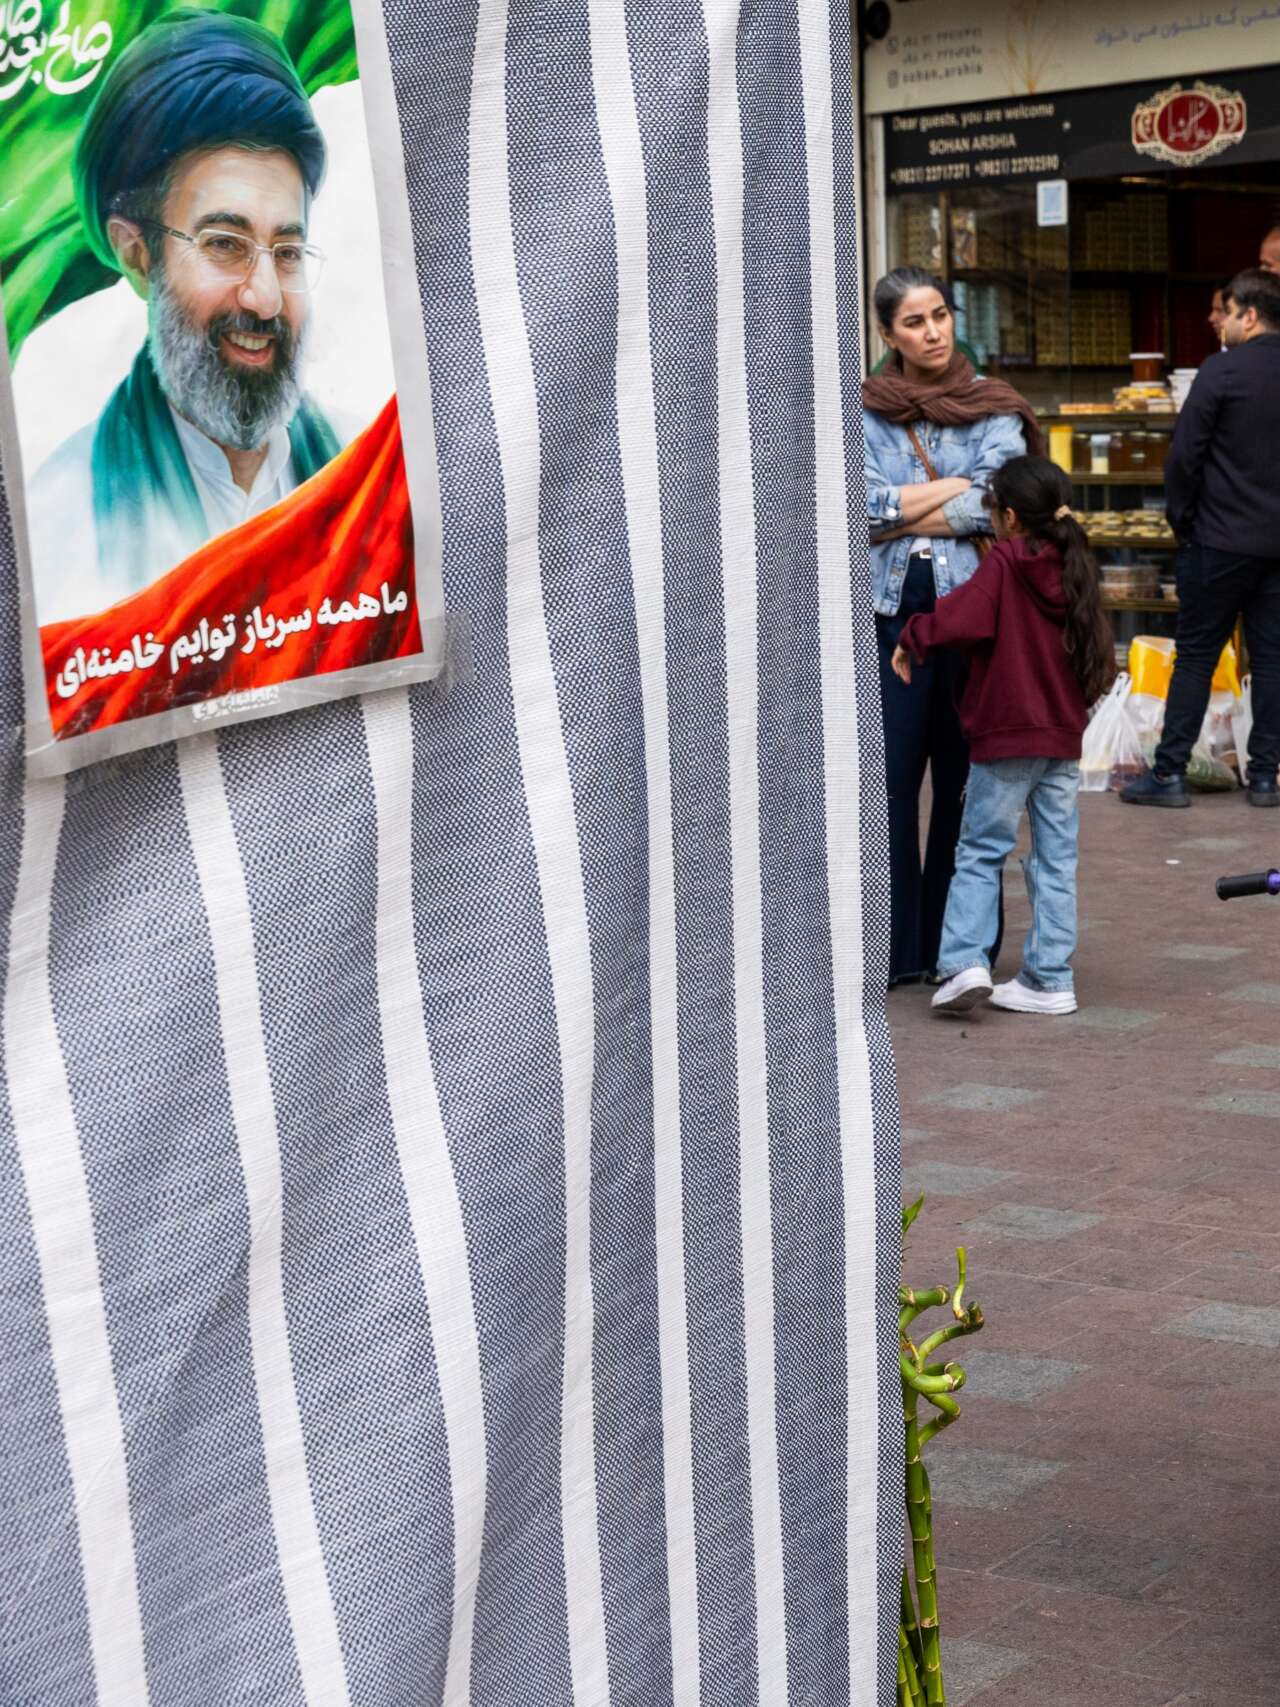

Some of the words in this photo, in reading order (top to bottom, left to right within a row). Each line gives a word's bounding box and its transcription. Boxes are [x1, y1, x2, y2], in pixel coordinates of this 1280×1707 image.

[44, 0, 113, 95] صالح
[892, 116, 918, 131] Dear
[961, 111, 983, 128] you
[984, 109, 1003, 122] are
[1004, 104, 1055, 120] welcome
[928, 137, 971, 156] SOHAN
[971, 133, 1017, 151] ARSHIA
[316, 591, 379, 626] همه
[380, 582, 409, 614] ما
[170, 613, 237, 674] توایم
[240, 605, 313, 654] سرباز
